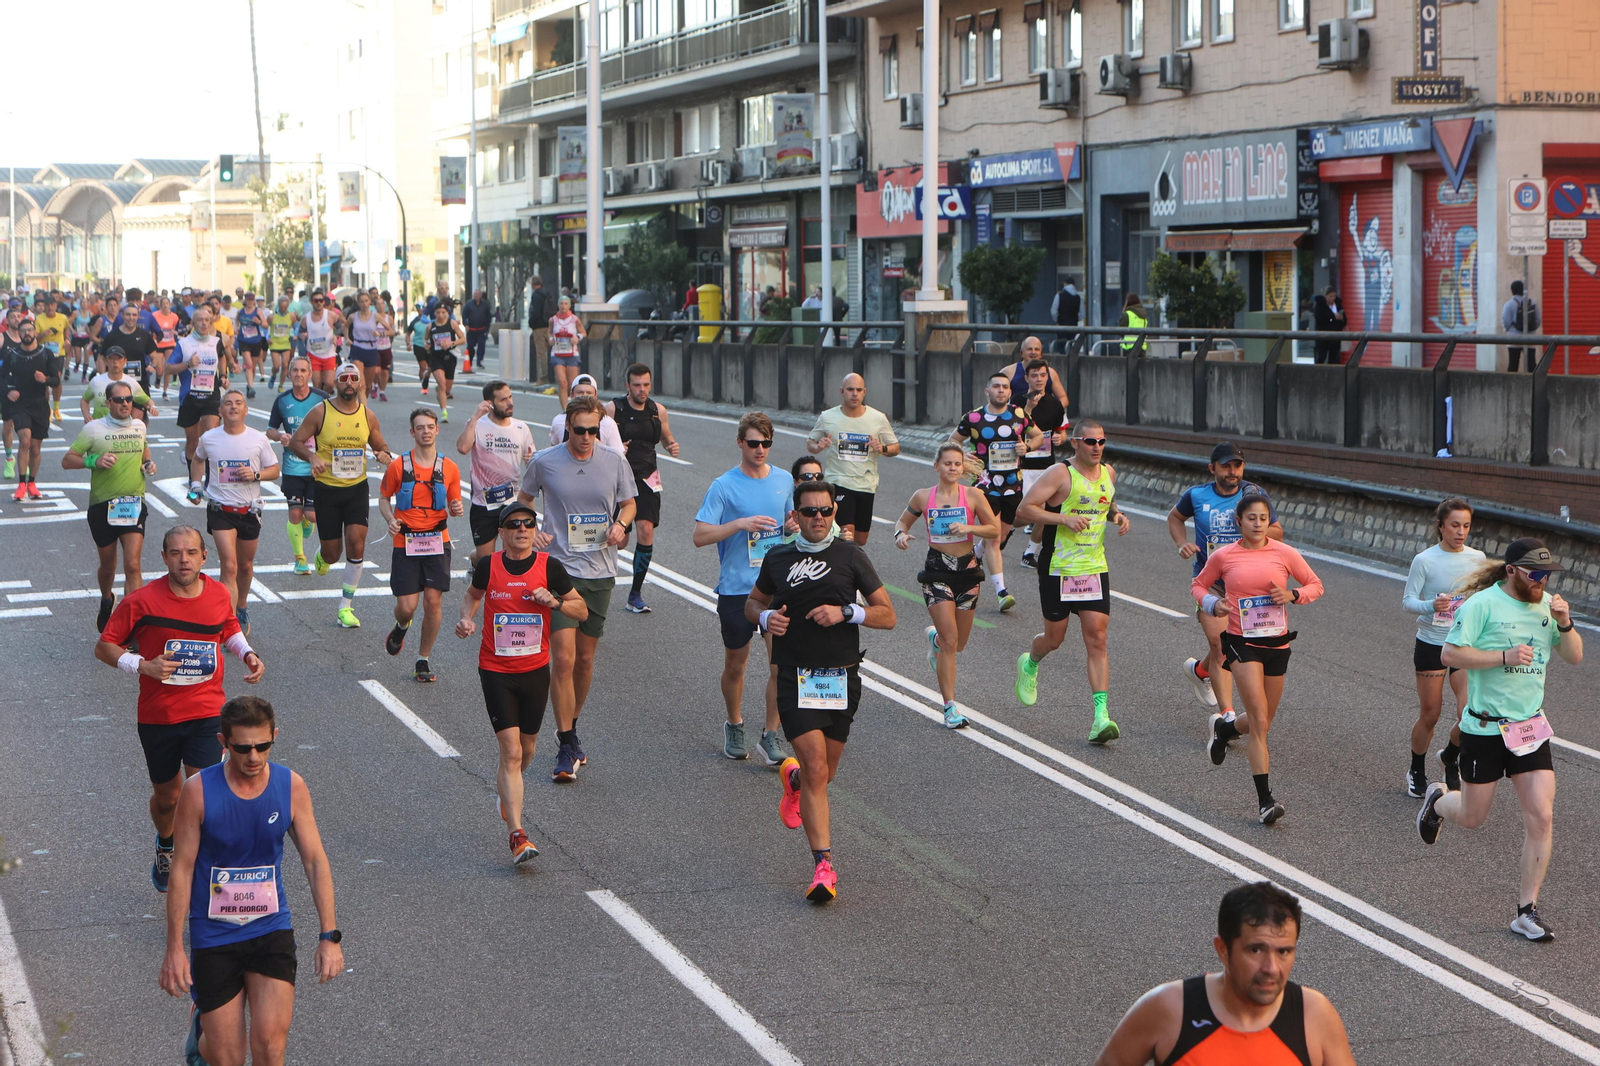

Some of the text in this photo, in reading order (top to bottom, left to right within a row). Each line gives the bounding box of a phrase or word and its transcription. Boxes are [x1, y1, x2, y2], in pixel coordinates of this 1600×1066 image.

[1402, 84, 1458, 98] HOSTAL
[1522, 91, 1600, 104] BENIDOR
[1343, 128, 1381, 151] JIMENEZ
[984, 161, 1020, 181] AUTOCLIMA
[112, 440, 141, 450] sano
[940, 509, 962, 517] ZURICH
[510, 616, 537, 624] ZURICH
[184, 643, 209, 653] ZURICH
[176, 668, 203, 676] ALFONSO
[813, 669, 841, 677] ZURICH
[814, 682, 831, 690] 4984
[233, 871, 268, 881] ZURICH
[233, 892, 255, 902] 8046
[220, 904, 269, 913] PIER GIORGIO
